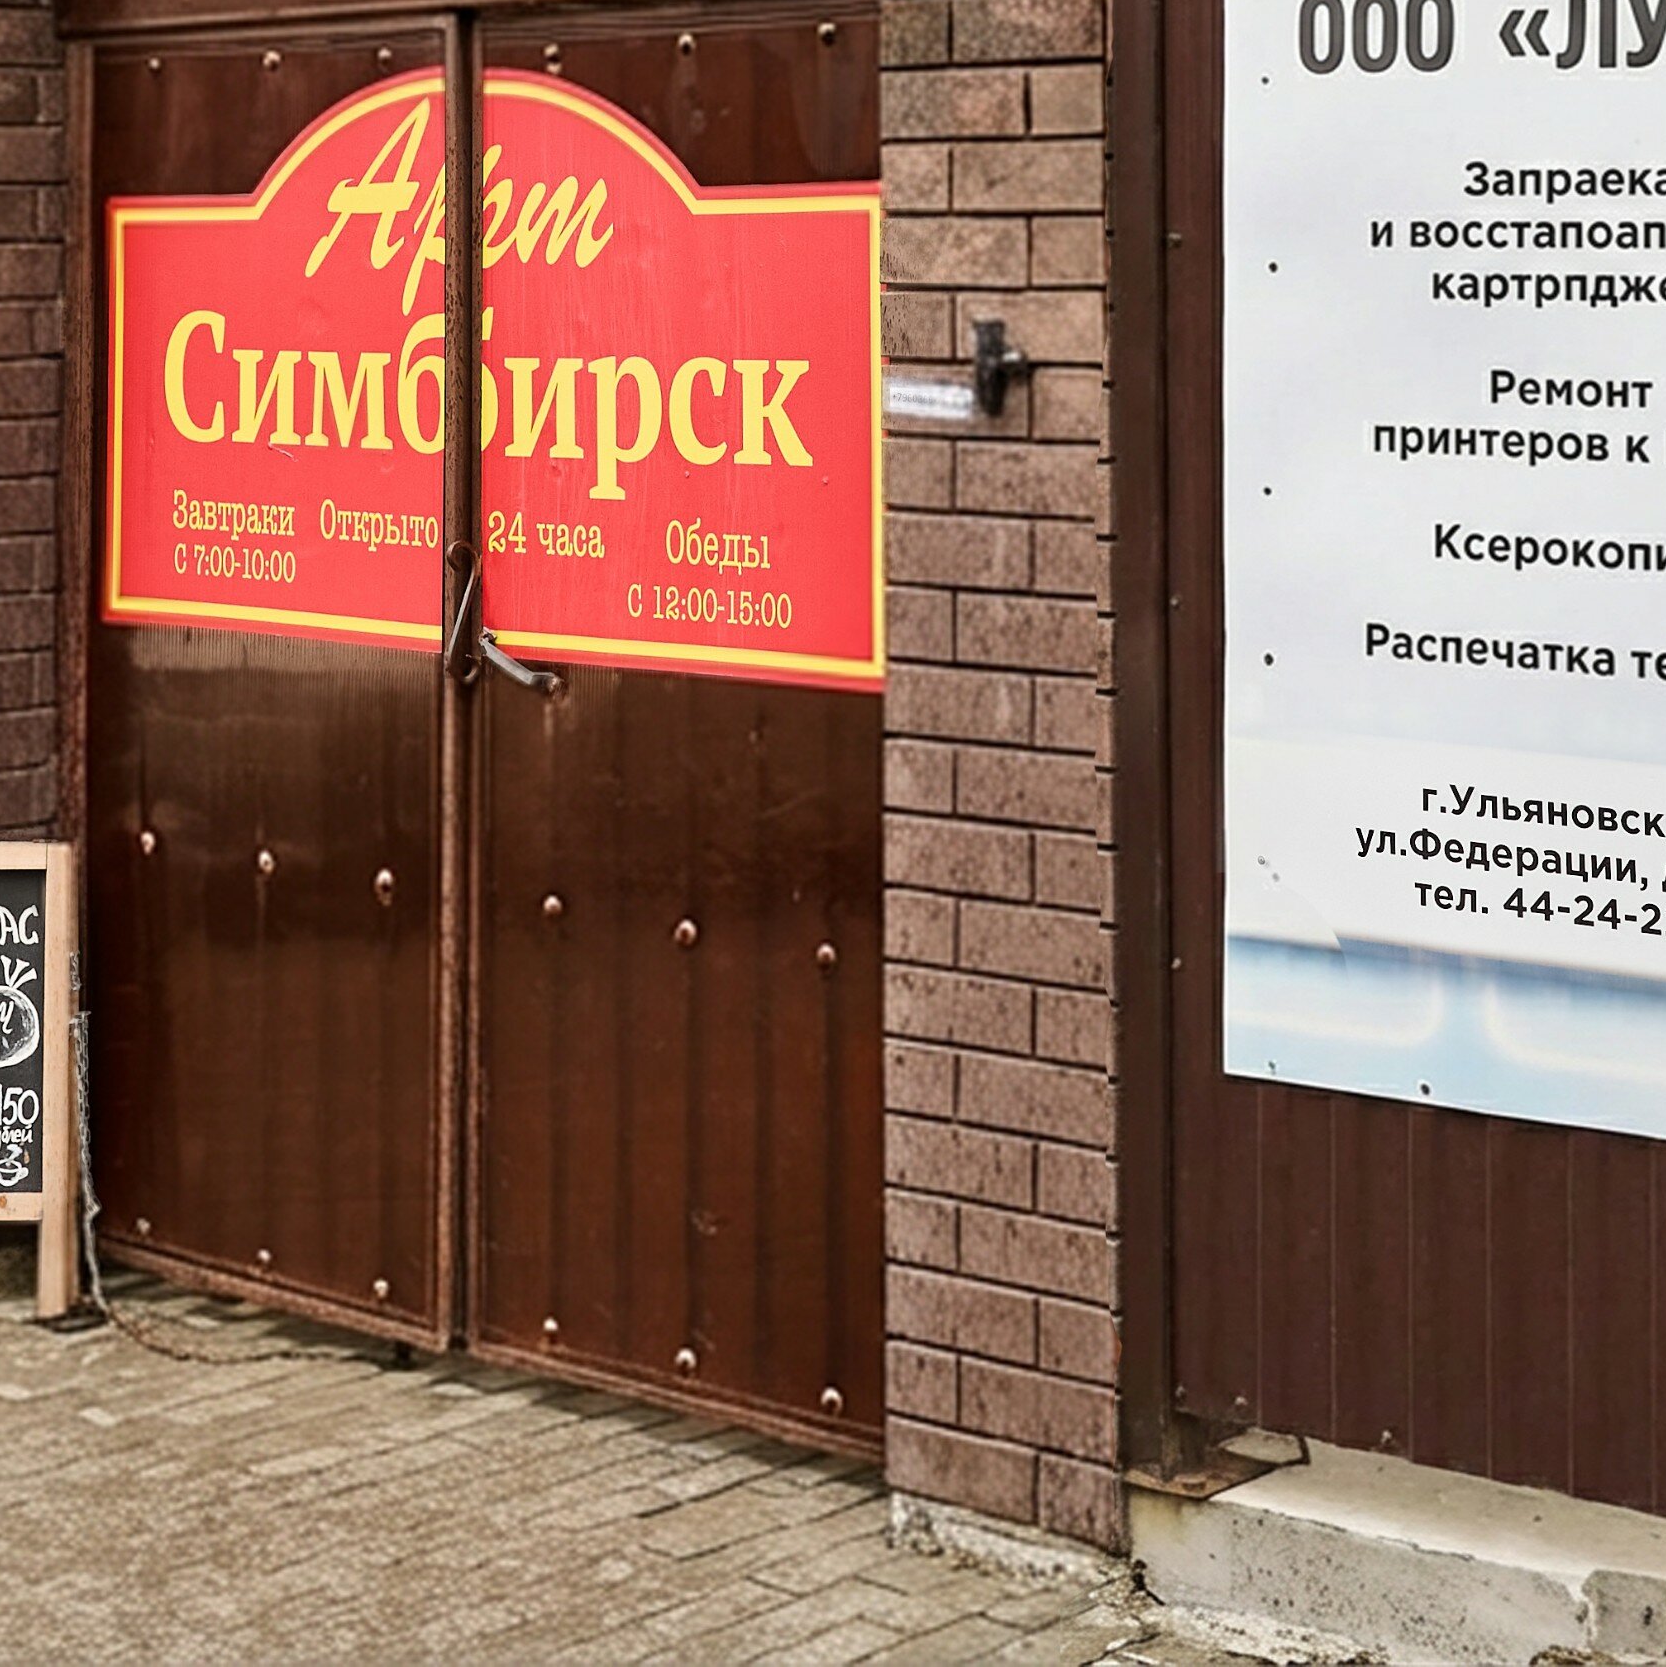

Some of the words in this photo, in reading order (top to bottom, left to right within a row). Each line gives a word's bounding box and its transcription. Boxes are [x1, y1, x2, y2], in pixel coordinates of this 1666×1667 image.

[1370, 221, 1393, 248] и
[163, 307, 814, 501] Симбирск
[1490, 369, 1654, 408] Ремонт
[1374, 424, 1610, 467] принтеров
[1625, 434, 1651, 464] к
[172, 489, 295, 541] Завтраки
[319, 498, 439, 552] Открыто
[487, 510, 527, 554] 24
[536, 521, 605, 559] часа
[173, 542, 187, 575] С
[193, 543, 297, 584] 7:00-10:00
[665, 517, 771, 575] Обеды
[627, 583, 643, 618] С
[652, 585, 793, 630] 12:00-15:00
[1364, 622, 1616, 677] Распечатка
[1355, 826, 1649, 892] ул.Федерации,
[1414, 880, 1489, 915] тел.
